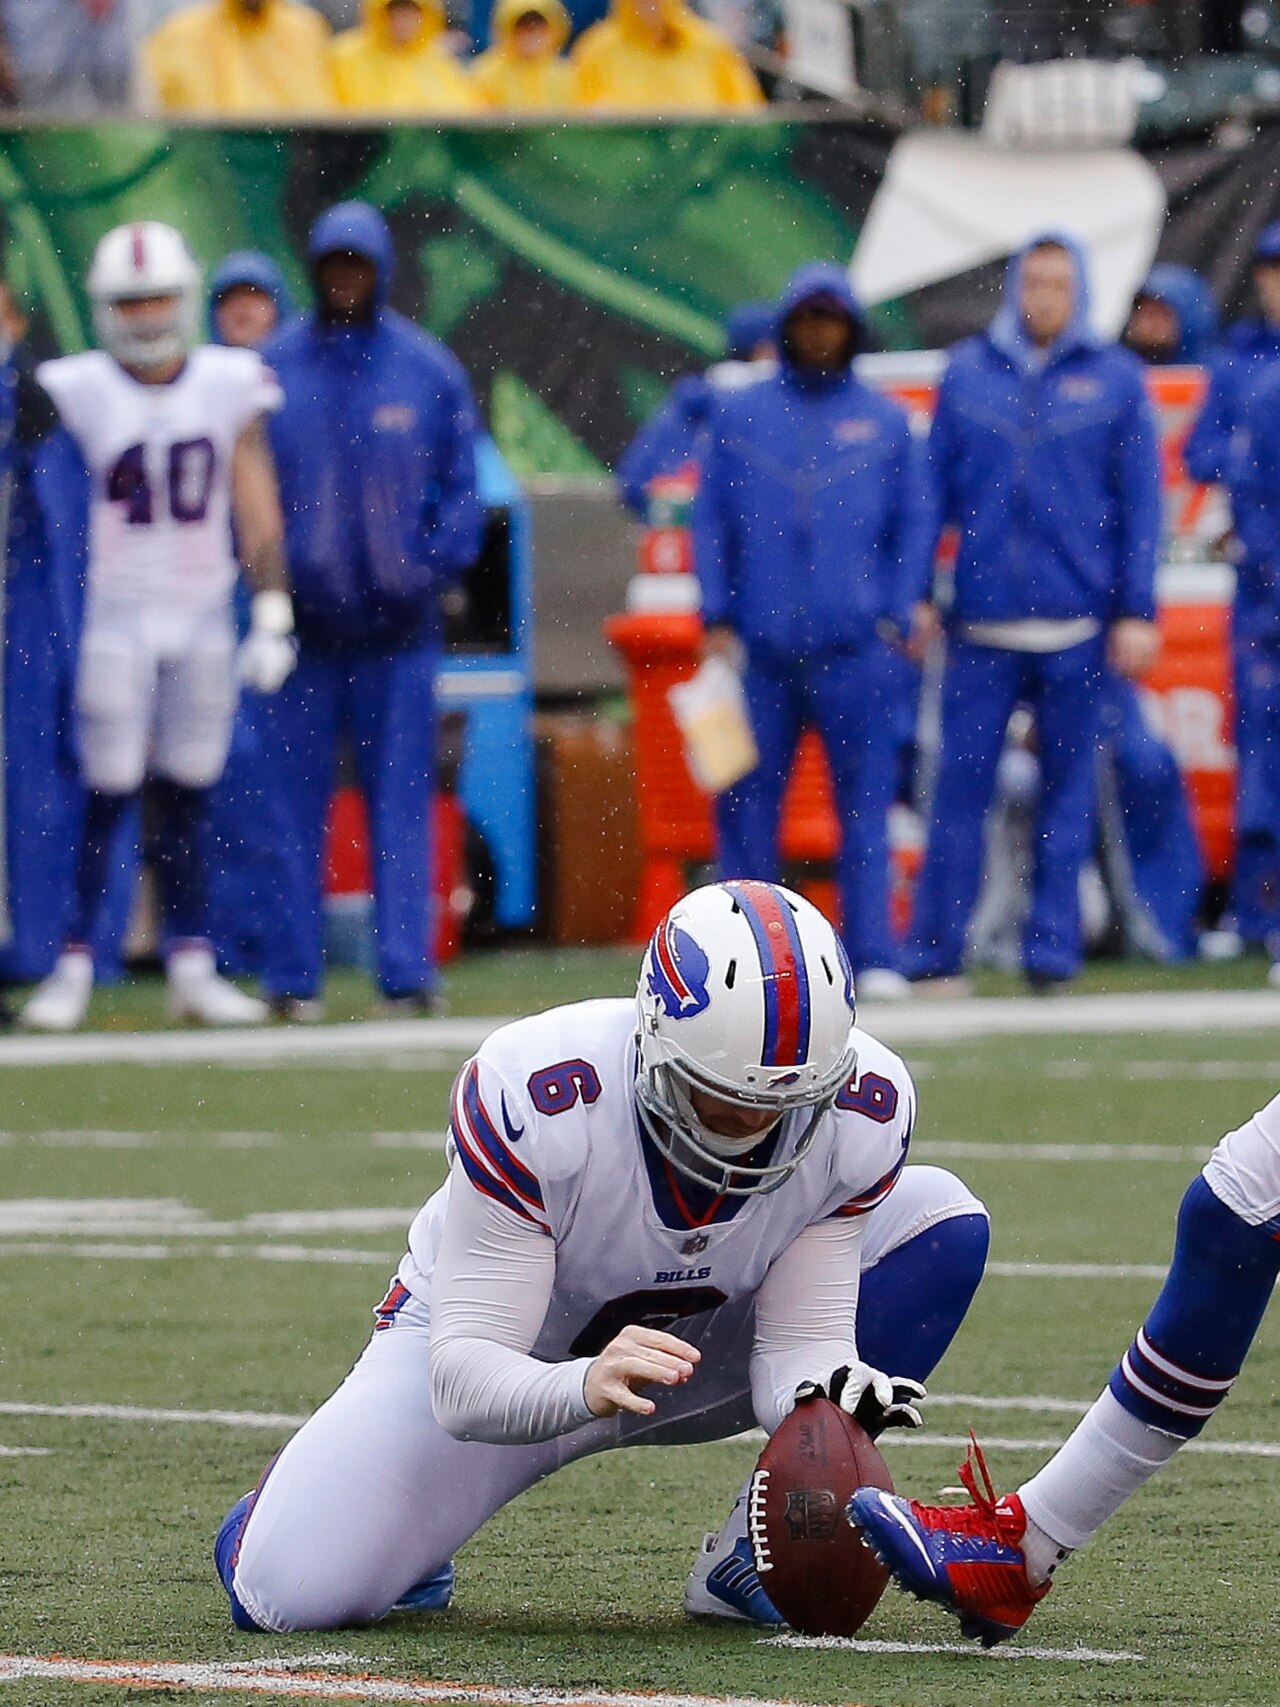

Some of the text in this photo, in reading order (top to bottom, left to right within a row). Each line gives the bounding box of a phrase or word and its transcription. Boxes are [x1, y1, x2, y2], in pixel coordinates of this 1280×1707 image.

[107, 438, 215, 524] 40
[527, 1058, 603, 1117] 6
[834, 1065, 899, 1124] 6
[653, 1266, 712, 1284] BILLS
